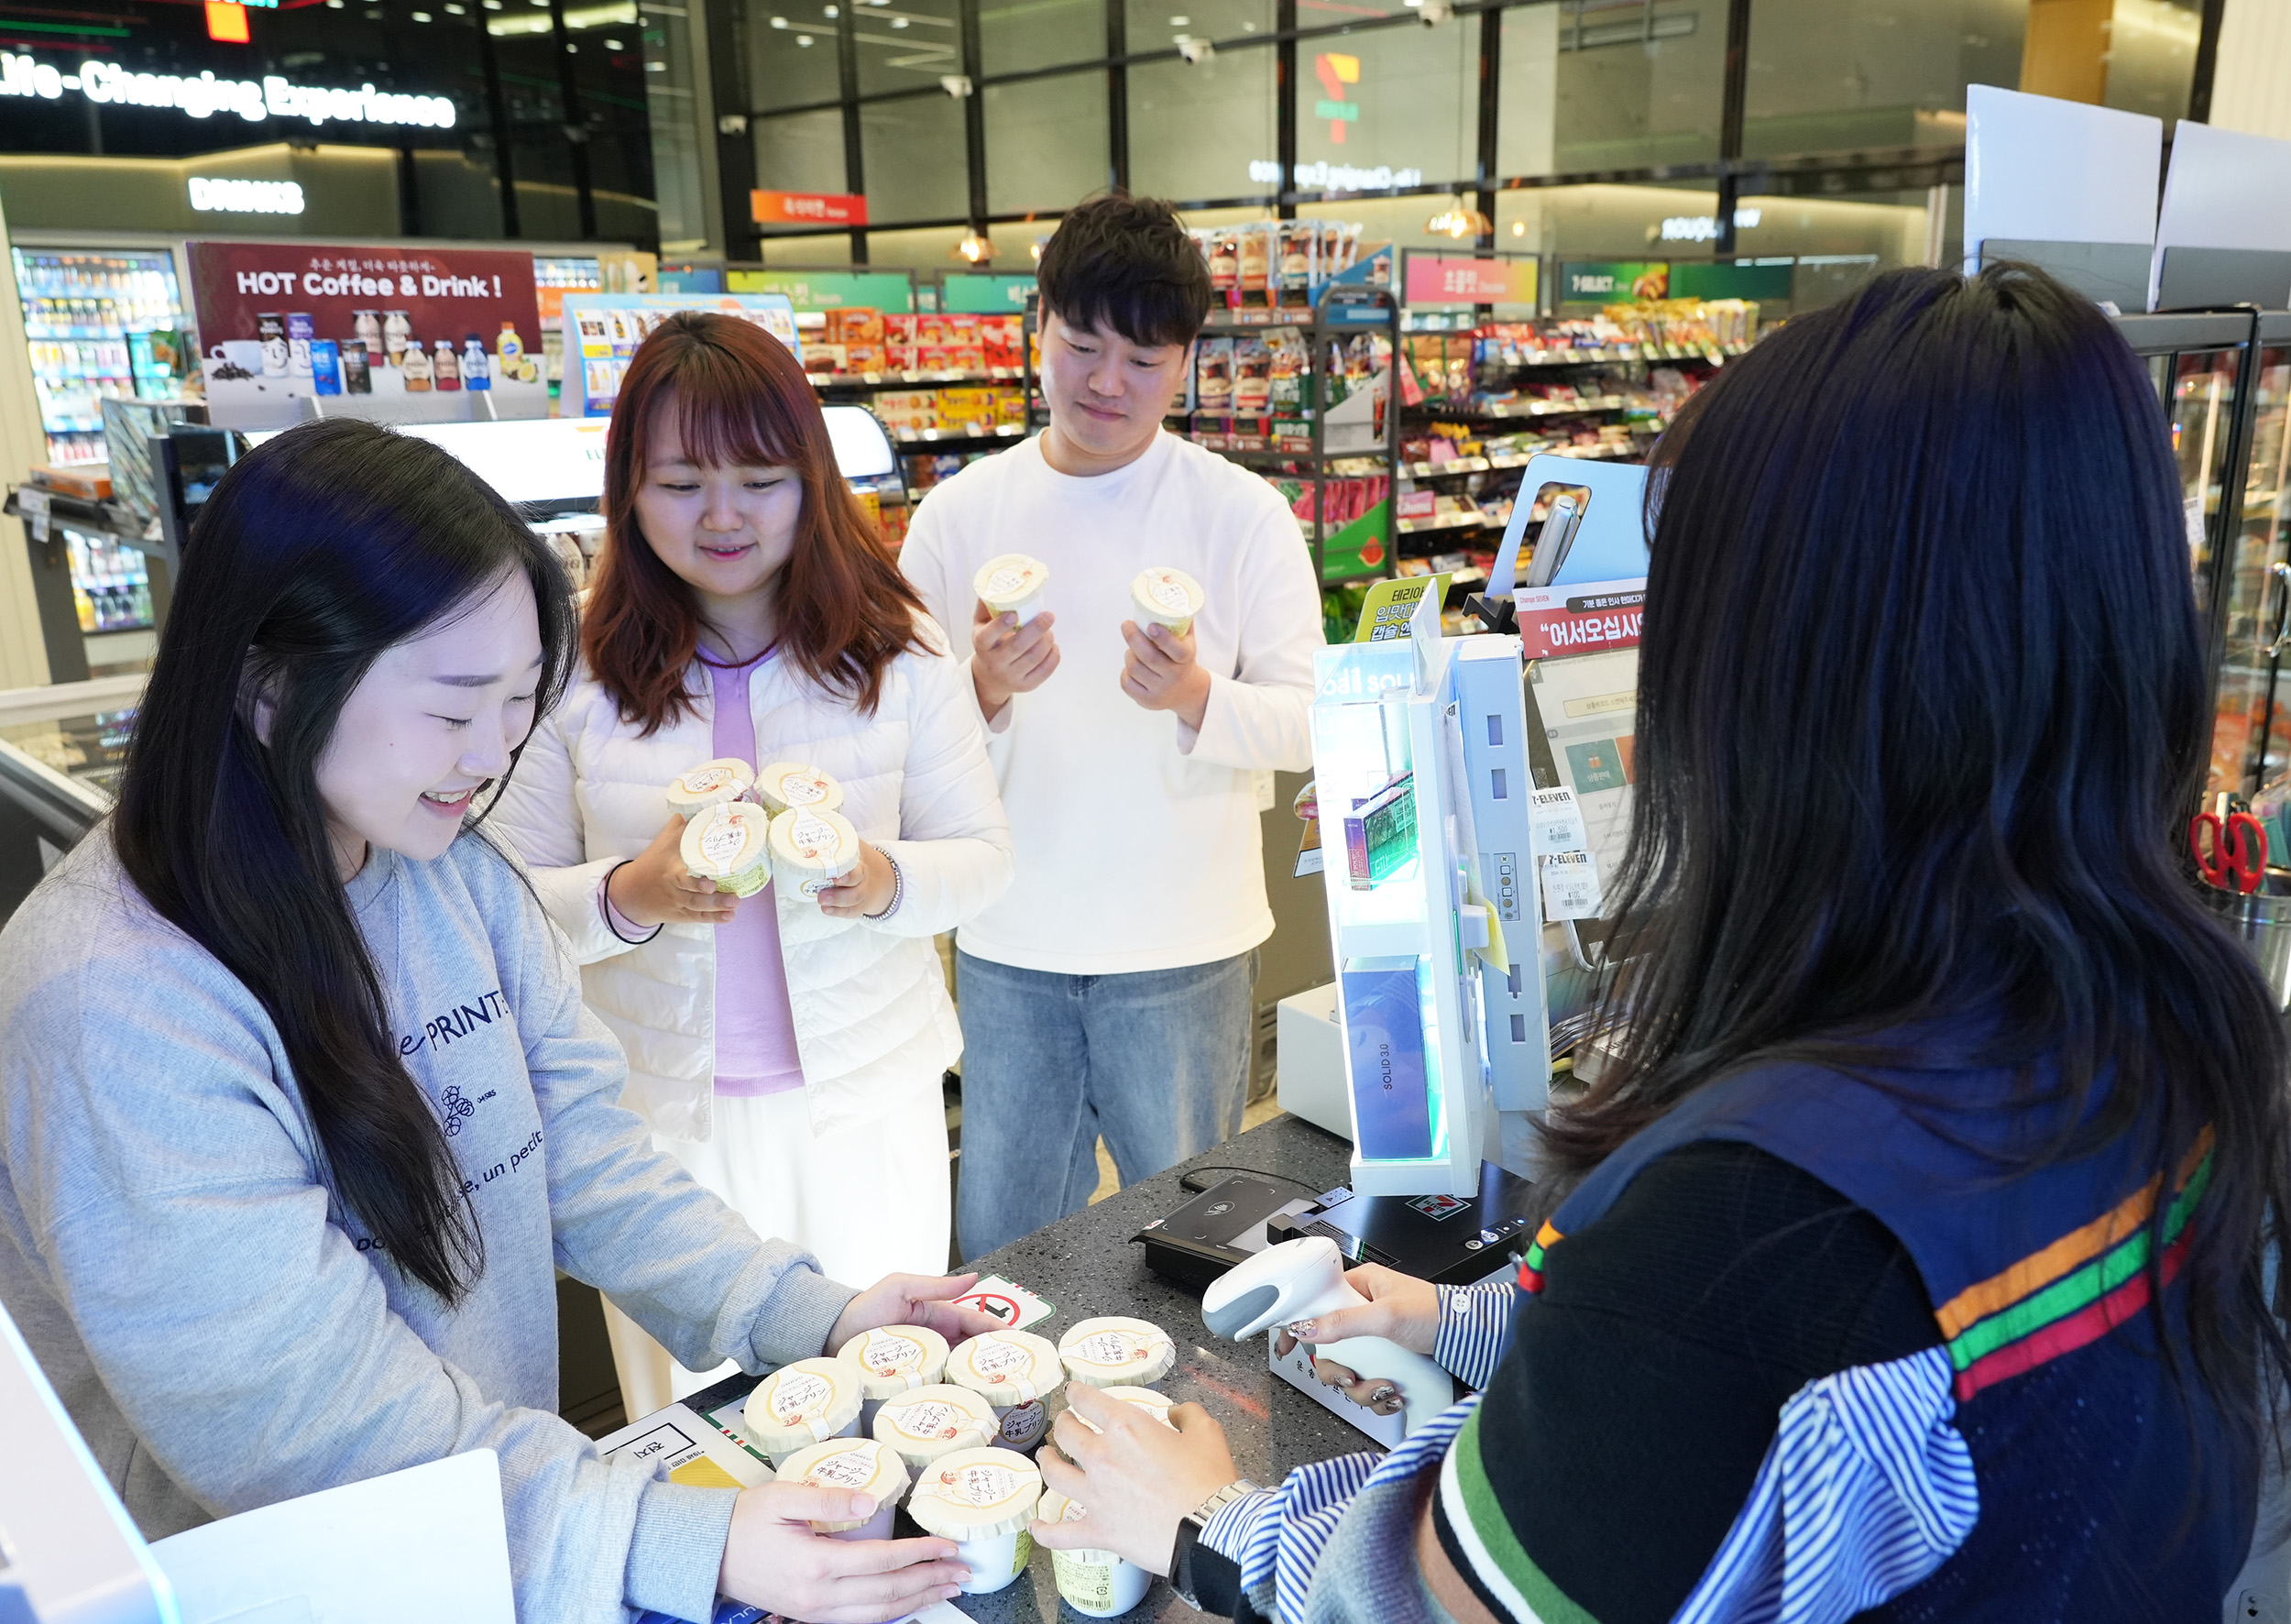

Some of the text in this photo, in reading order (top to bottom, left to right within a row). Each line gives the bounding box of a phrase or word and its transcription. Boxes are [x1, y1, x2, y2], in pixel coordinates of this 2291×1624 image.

[236, 271, 503, 298] HOT Coffee & Drink !
[1375, 601, 1419, 623] 입맛대
[1583, 599, 1595, 609] 기분
[1595, 598, 1608, 608] 좋은
[1608, 597, 1621, 606] 인사
[1370, 623, 1399, 642] 캡슐
[426, 990, 509, 1051] PRINT
[1379, 1044, 1392, 1090] SOLID 3.0
[483, 1162, 506, 1183] un
[510, 1130, 543, 1173] petit
[1004, 1419, 1042, 1438] 牛乳プリン
[1006, 1410, 1042, 1430] ジャージー
